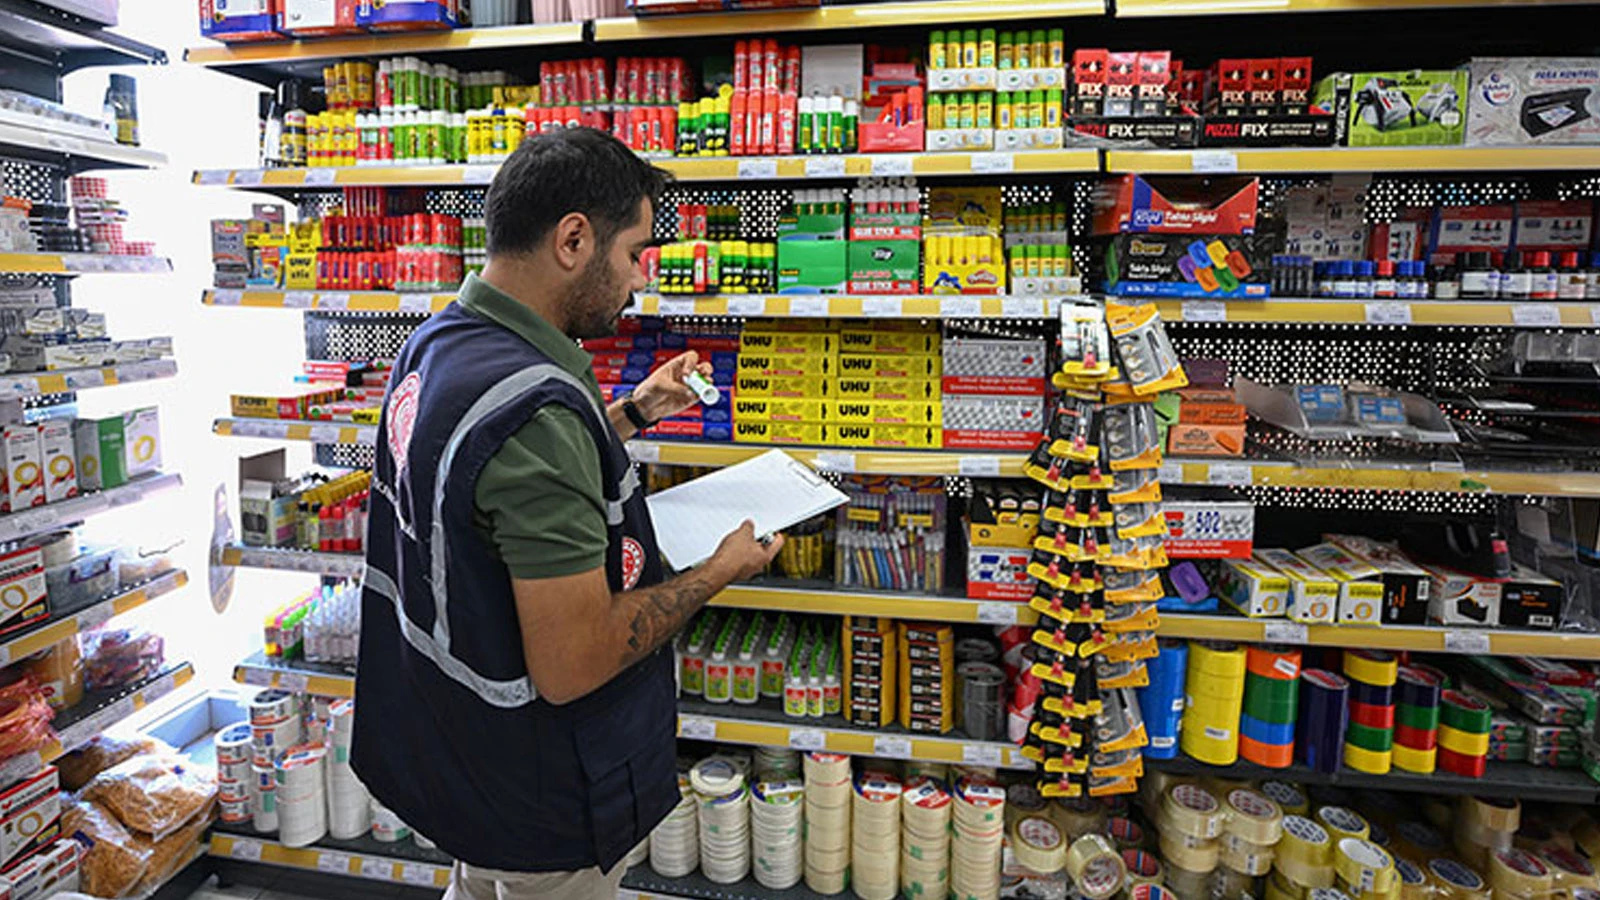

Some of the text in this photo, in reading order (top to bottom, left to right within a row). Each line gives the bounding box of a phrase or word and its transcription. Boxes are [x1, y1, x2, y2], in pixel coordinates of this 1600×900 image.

[1078, 83, 1102, 95] FIX
[1107, 85, 1133, 97] FIX
[1140, 84, 1165, 96] FIX
[1282, 89, 1308, 101] FIX
[1222, 90, 1245, 103] FIX
[1251, 90, 1275, 103] FIX
[1108, 124, 1135, 137] FIX
[1205, 123, 1241, 137] PUZZLE
[1241, 123, 1269, 137] FIX
[743, 335, 773, 346] UHU
[843, 334, 873, 345] UHU
[740, 357, 770, 369] UHU
[842, 358, 873, 370] UHU
[740, 379, 769, 390] UHU
[840, 381, 870, 392] UHU
[737, 402, 767, 413] UHU
[839, 404, 870, 416] UHU
[737, 424, 767, 435] UHU
[839, 427, 870, 439] UHU
[1196, 511, 1220, 533] 502
